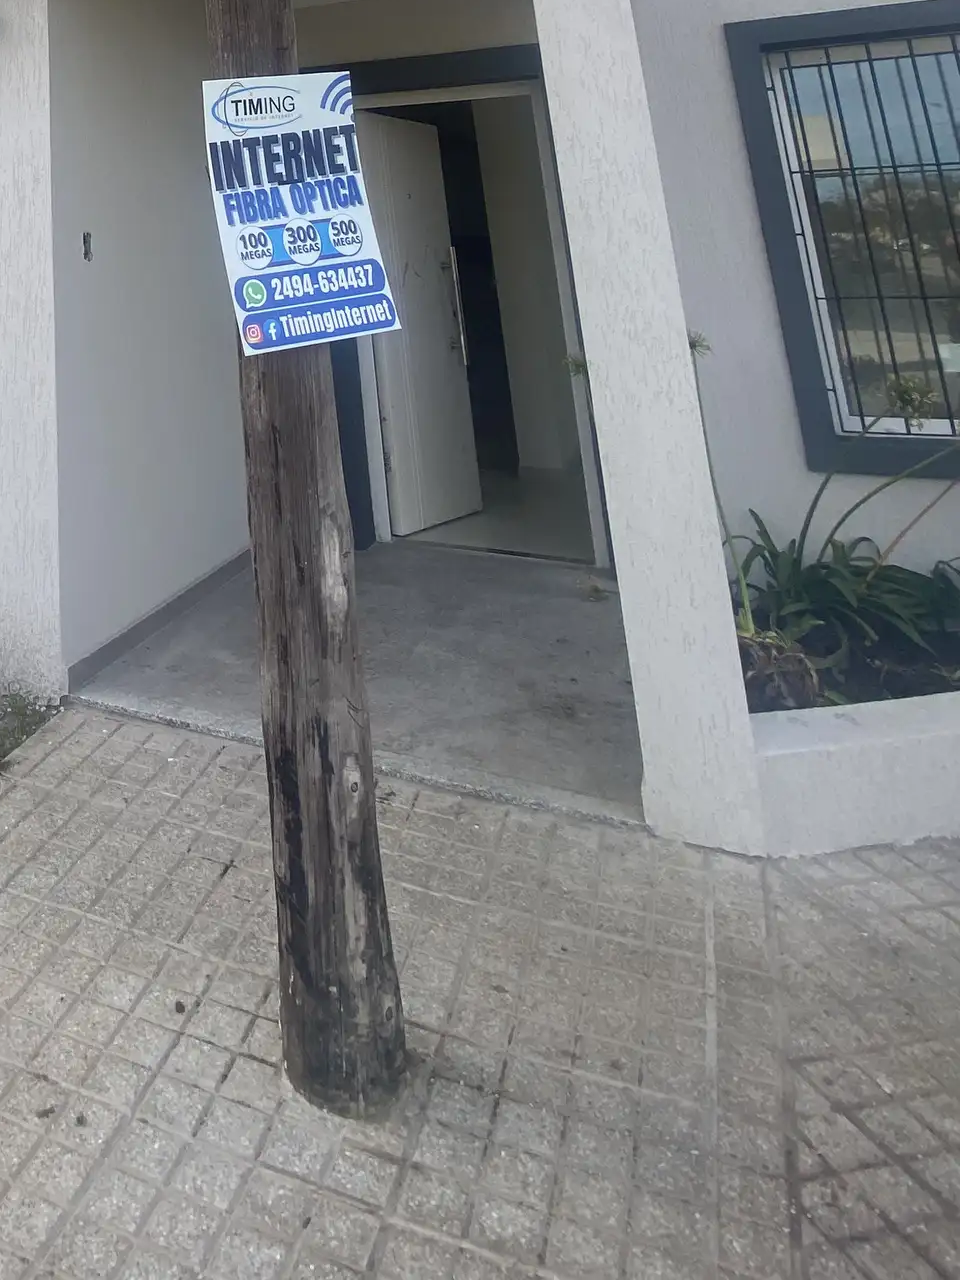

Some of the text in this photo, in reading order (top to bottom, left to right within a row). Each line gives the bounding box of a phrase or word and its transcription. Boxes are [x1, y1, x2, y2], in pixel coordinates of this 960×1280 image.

[231, 95, 295, 117] TIMING
[209, 124, 360, 193] INTERNET
[223, 175, 364, 226] FIBRA OPTICA
[286, 225, 318, 245] 300
[331, 220, 358, 237] 500
[239, 232, 268, 250] 100
[288, 243, 320, 255] MEGAS
[333, 235, 361, 247] MEGAS
[240, 248, 272, 261] MEGAS
[271, 264, 374, 301] 2494-634437
[279, 300, 392, 338] TimingInternet
